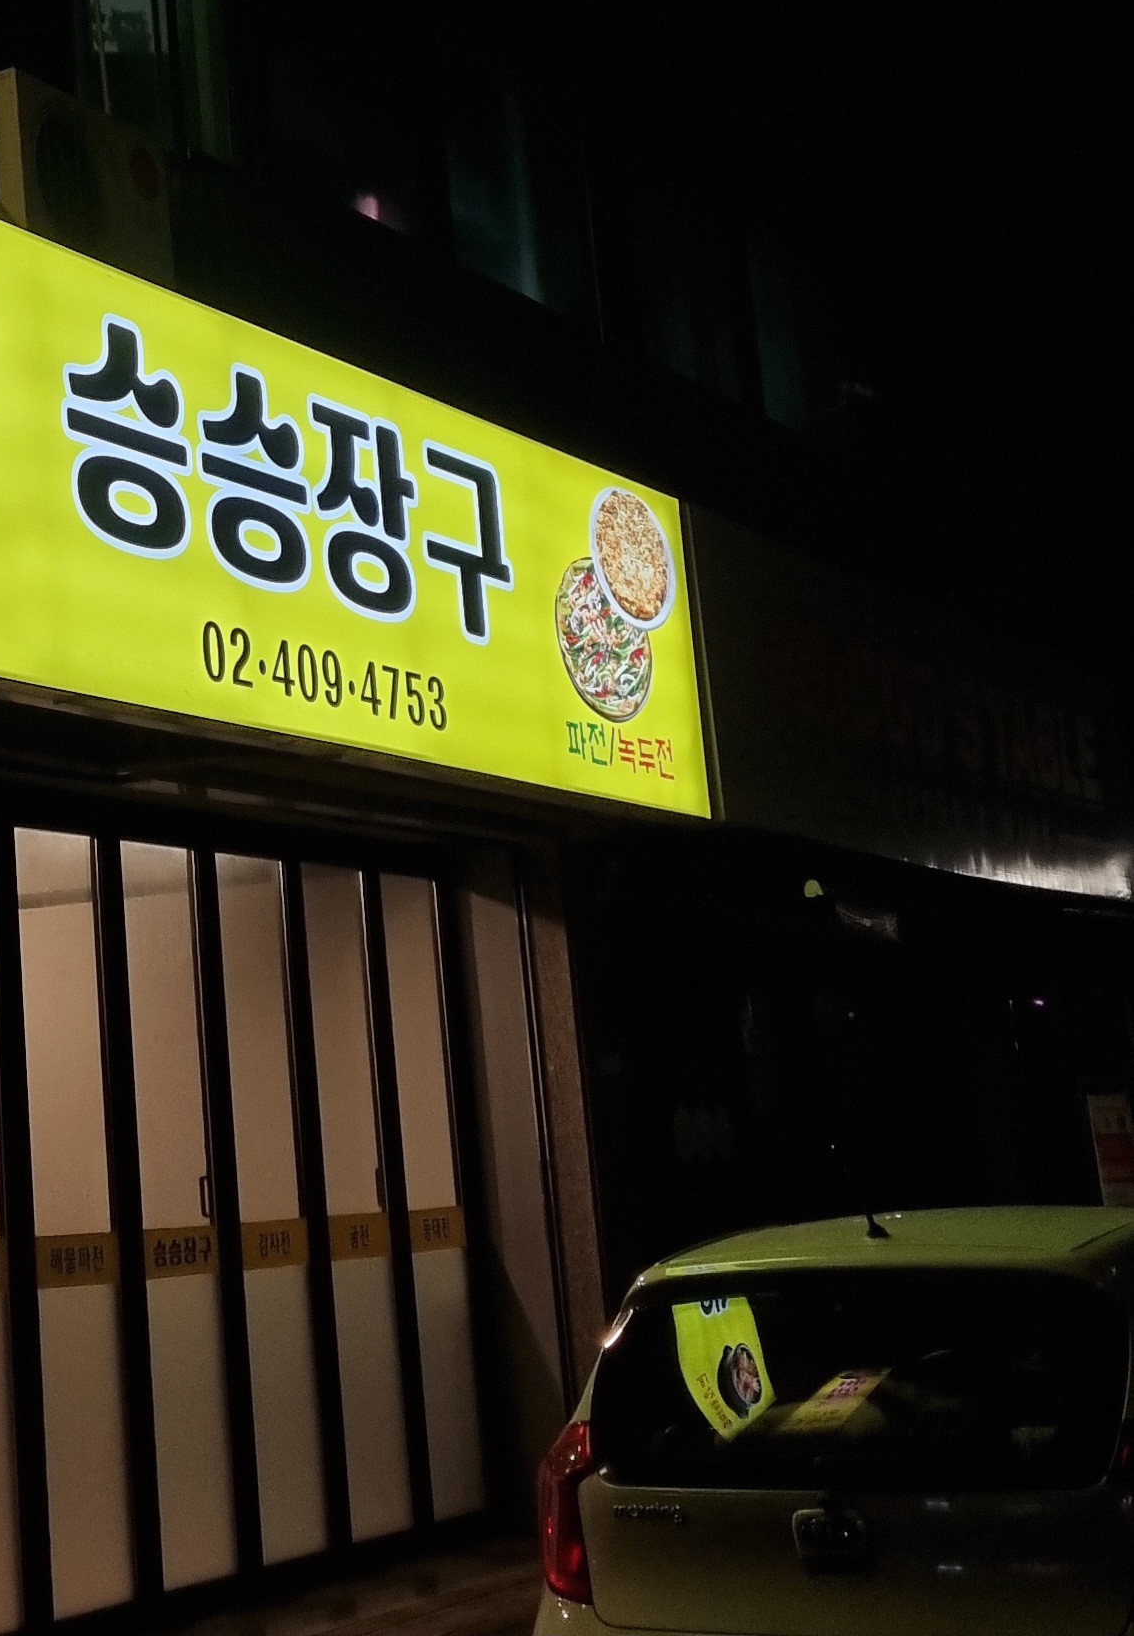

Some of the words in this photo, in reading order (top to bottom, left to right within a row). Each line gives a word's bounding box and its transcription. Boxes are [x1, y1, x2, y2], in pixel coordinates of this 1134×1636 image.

[63, 313, 513, 644] 승승장구
[50, 1245, 104, 1274] 해물파전
[153, 1235, 211, 1266] 승승장구
